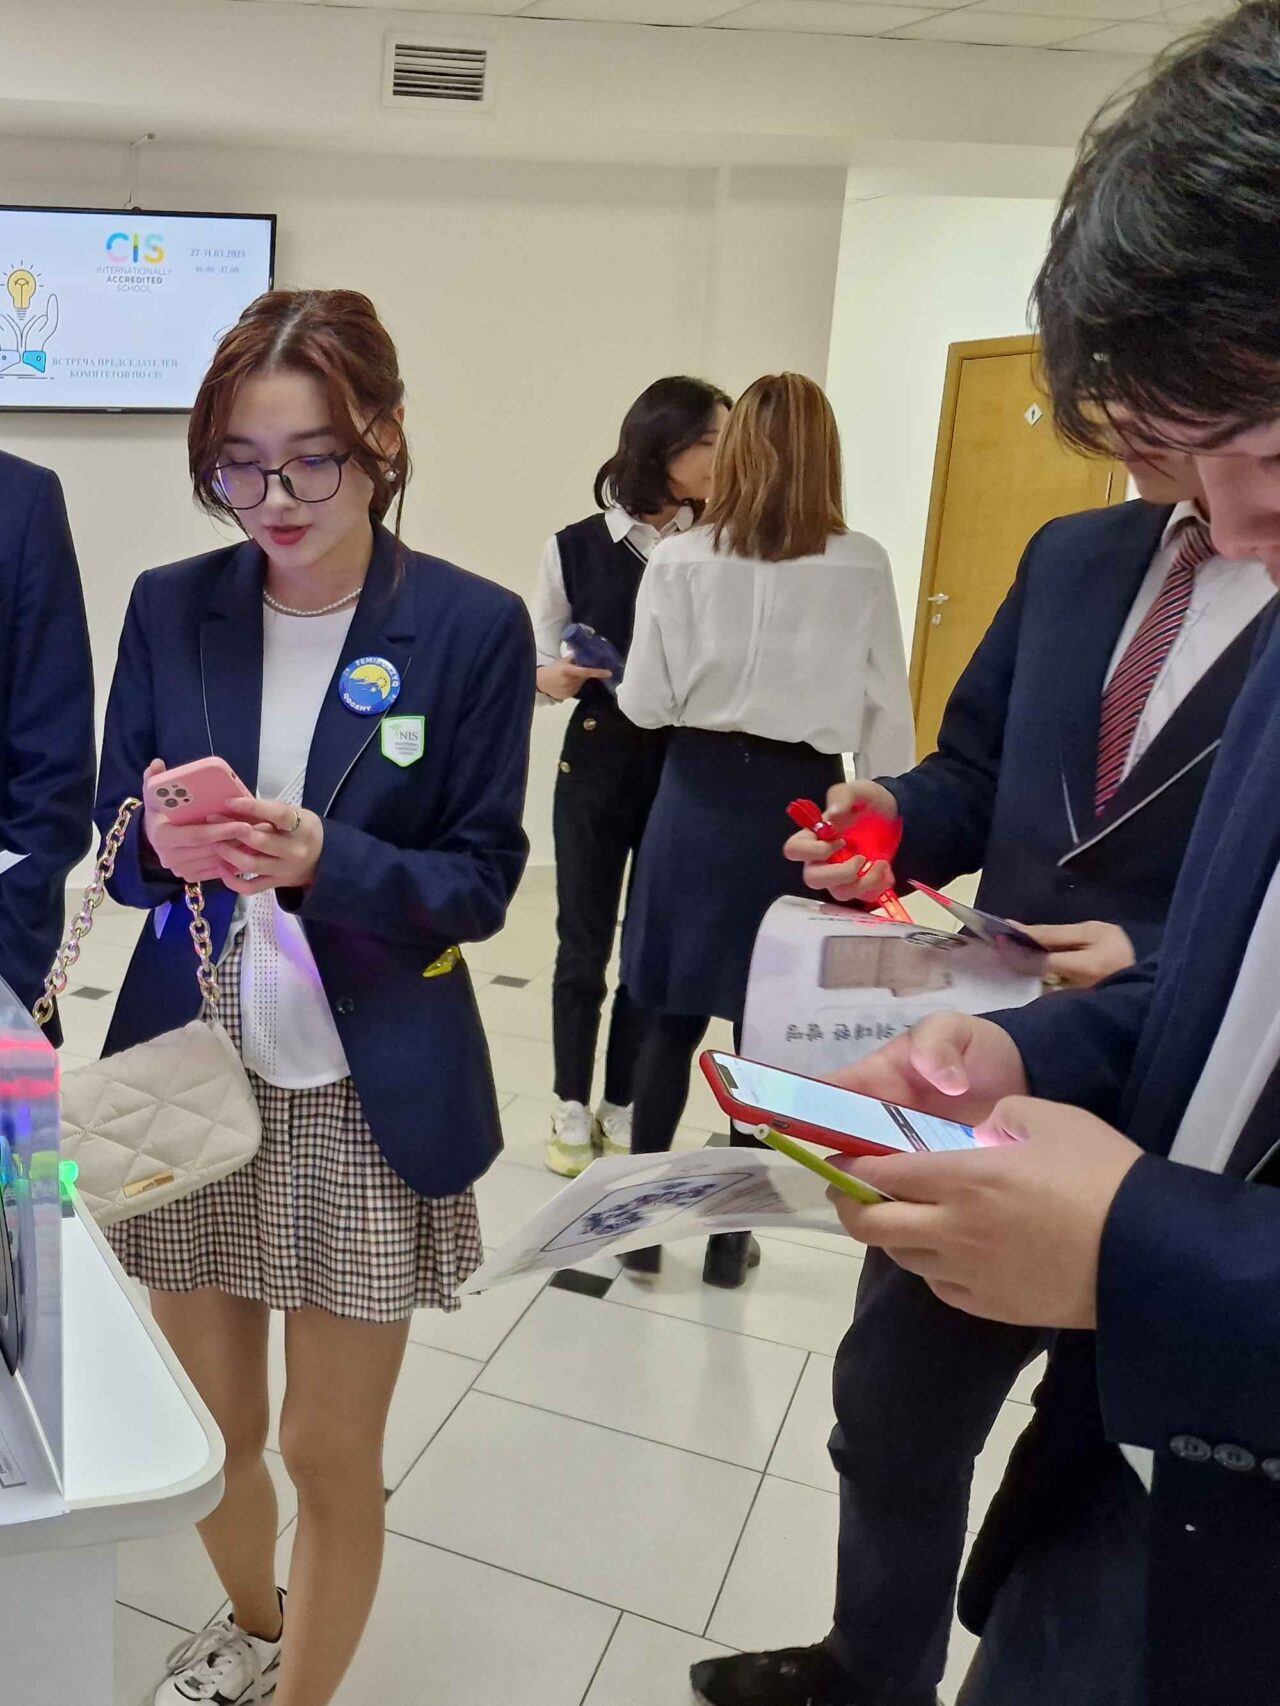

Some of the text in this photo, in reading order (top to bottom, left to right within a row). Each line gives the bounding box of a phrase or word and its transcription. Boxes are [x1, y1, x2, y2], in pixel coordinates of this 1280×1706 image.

[106, 232, 165, 264] CIS
[96, 266, 173, 276] INTERNATIONALLY
[106, 276, 163, 285] ACCREDITED
[116, 284, 151, 293] SCHOOL
[399, 731, 418, 741] NIS
